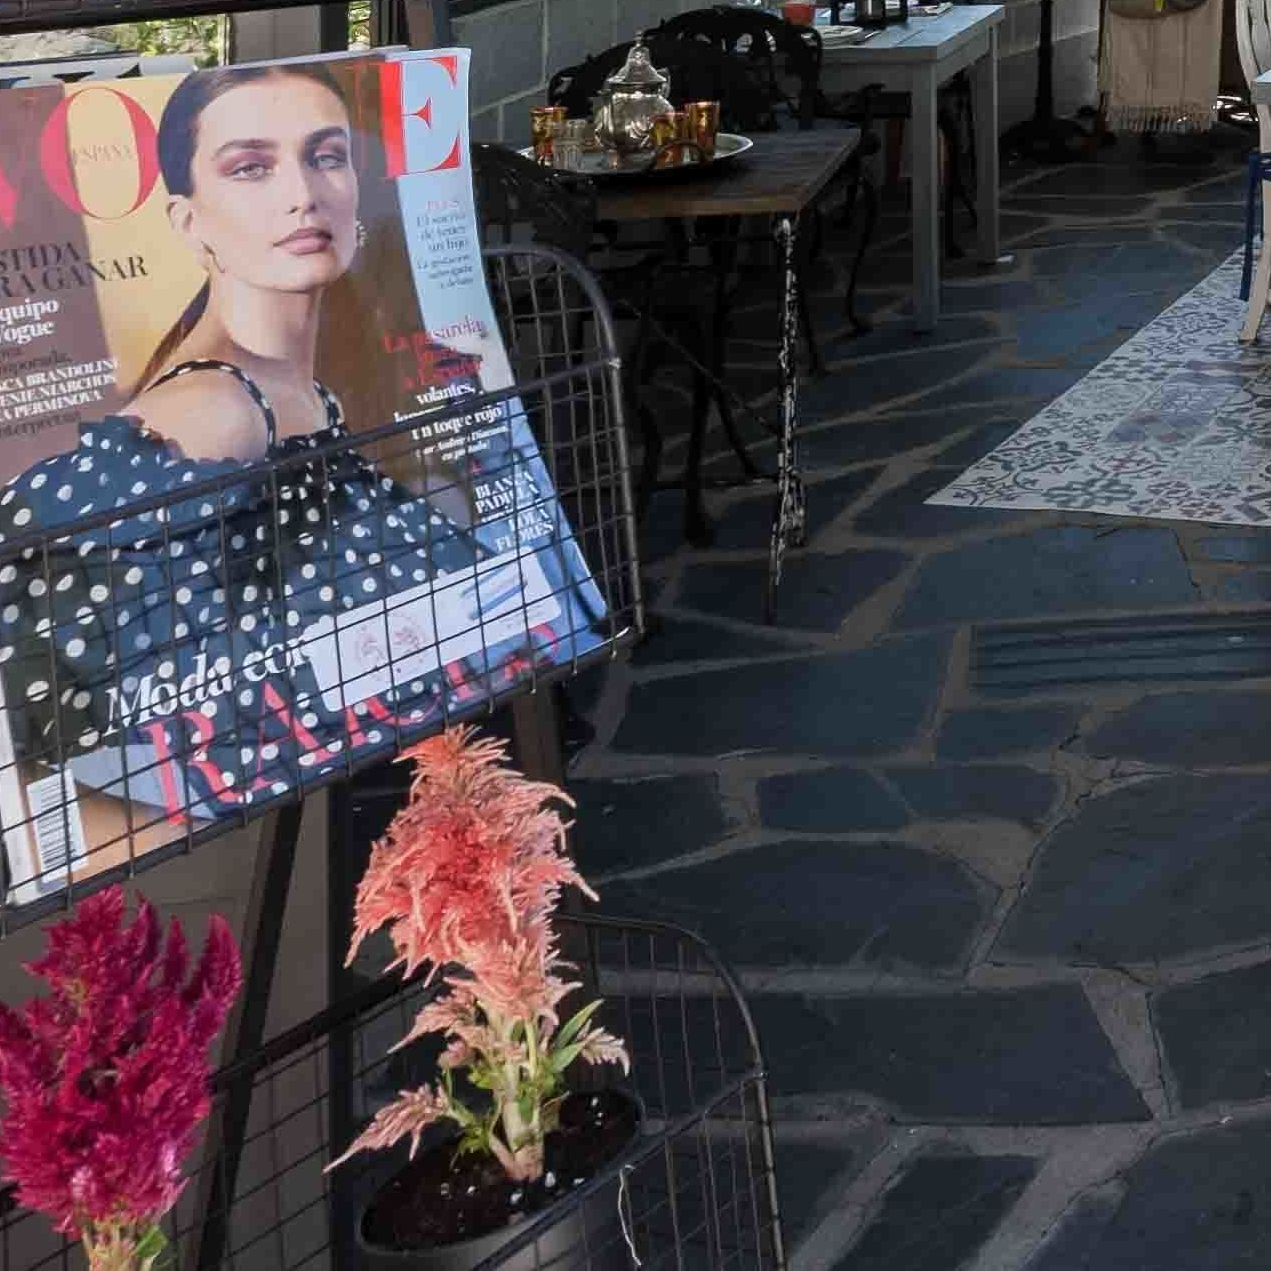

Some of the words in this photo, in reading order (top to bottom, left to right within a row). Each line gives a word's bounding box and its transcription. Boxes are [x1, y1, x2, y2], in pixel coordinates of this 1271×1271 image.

[41, 255, 149, 293] GANAR
[14, 390, 104, 419] PERMINOVA
[474, 404, 503, 423] rojo
[103, 652, 235, 737] Moda
